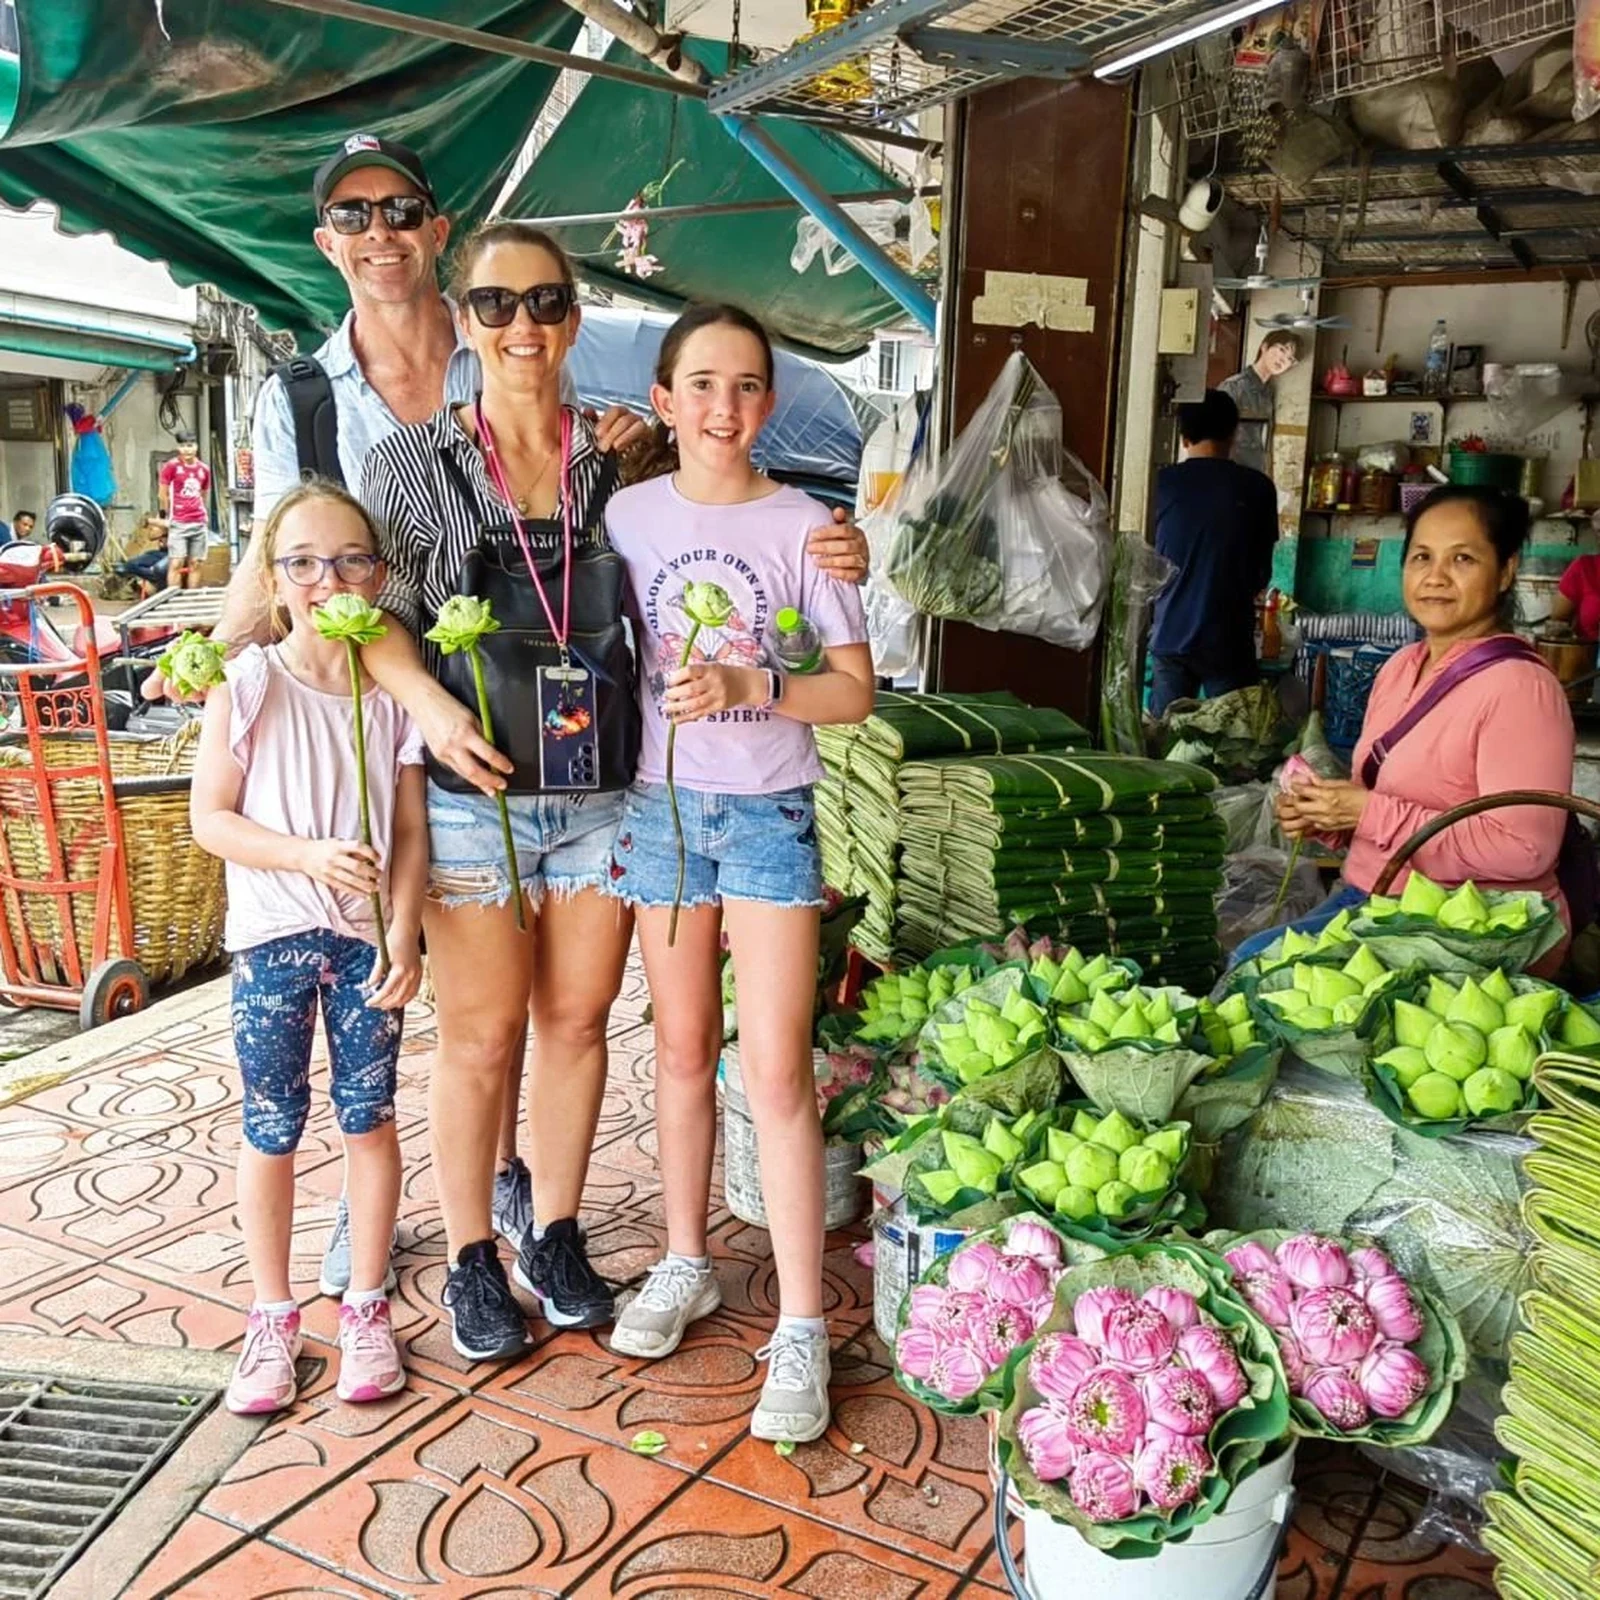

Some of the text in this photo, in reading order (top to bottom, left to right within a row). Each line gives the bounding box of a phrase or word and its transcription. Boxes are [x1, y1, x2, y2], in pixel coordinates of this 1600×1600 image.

[646, 567, 668, 638] OLLOW
[669, 549, 717, 571] YOUR
[723, 553, 760, 586] OWN
[706, 708, 770, 723] SPIRIT
[266, 949, 323, 968] LOVE
[248, 993, 283, 1007] STAND
